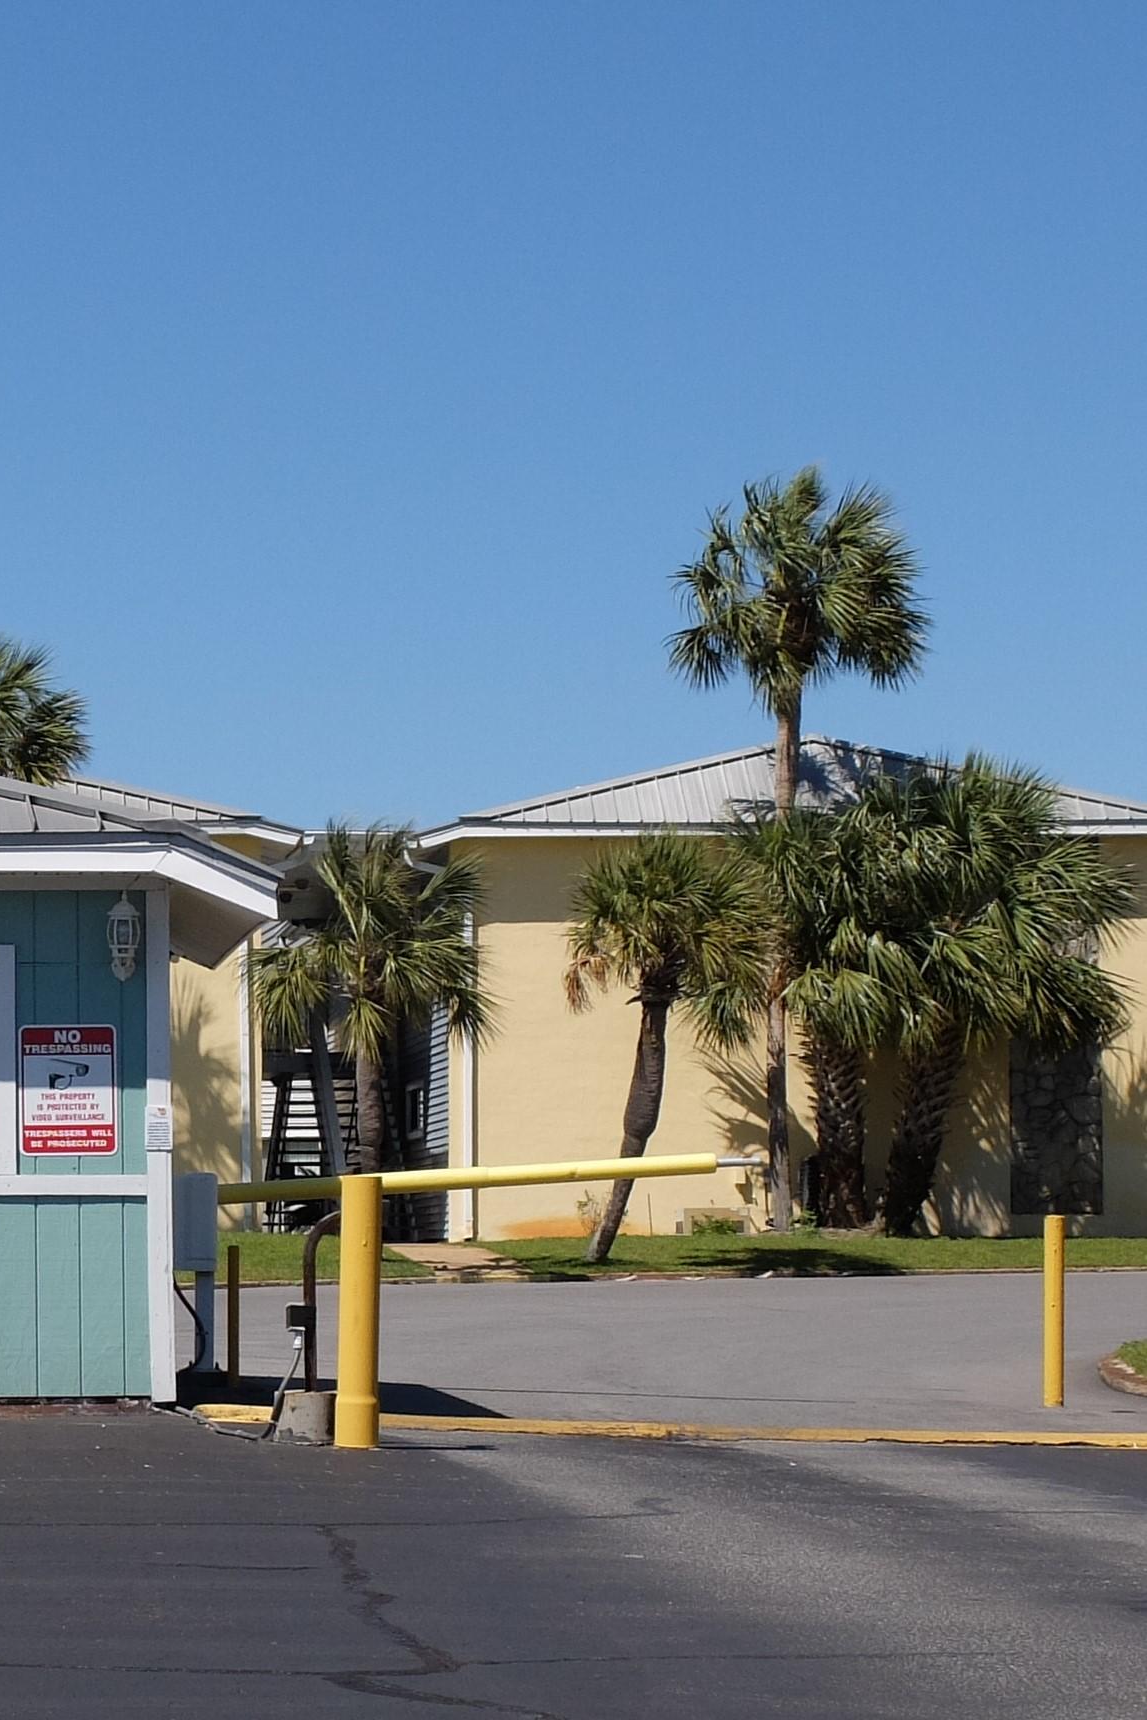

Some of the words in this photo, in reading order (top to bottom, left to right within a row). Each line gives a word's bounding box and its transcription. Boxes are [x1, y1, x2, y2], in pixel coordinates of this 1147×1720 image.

[54, 1030, 81, 1043] NO
[23, 1044, 111, 1054] TRESPASSING
[60, 1092, 95, 1100] PROPERTY
[55, 1113, 105, 1121] SURVEILLANCE
[24, 1129, 87, 1137] TRESPASSERS
[92, 1129, 113, 1137] WILL
[47, 1139, 107, 1147] PROSECUTED
